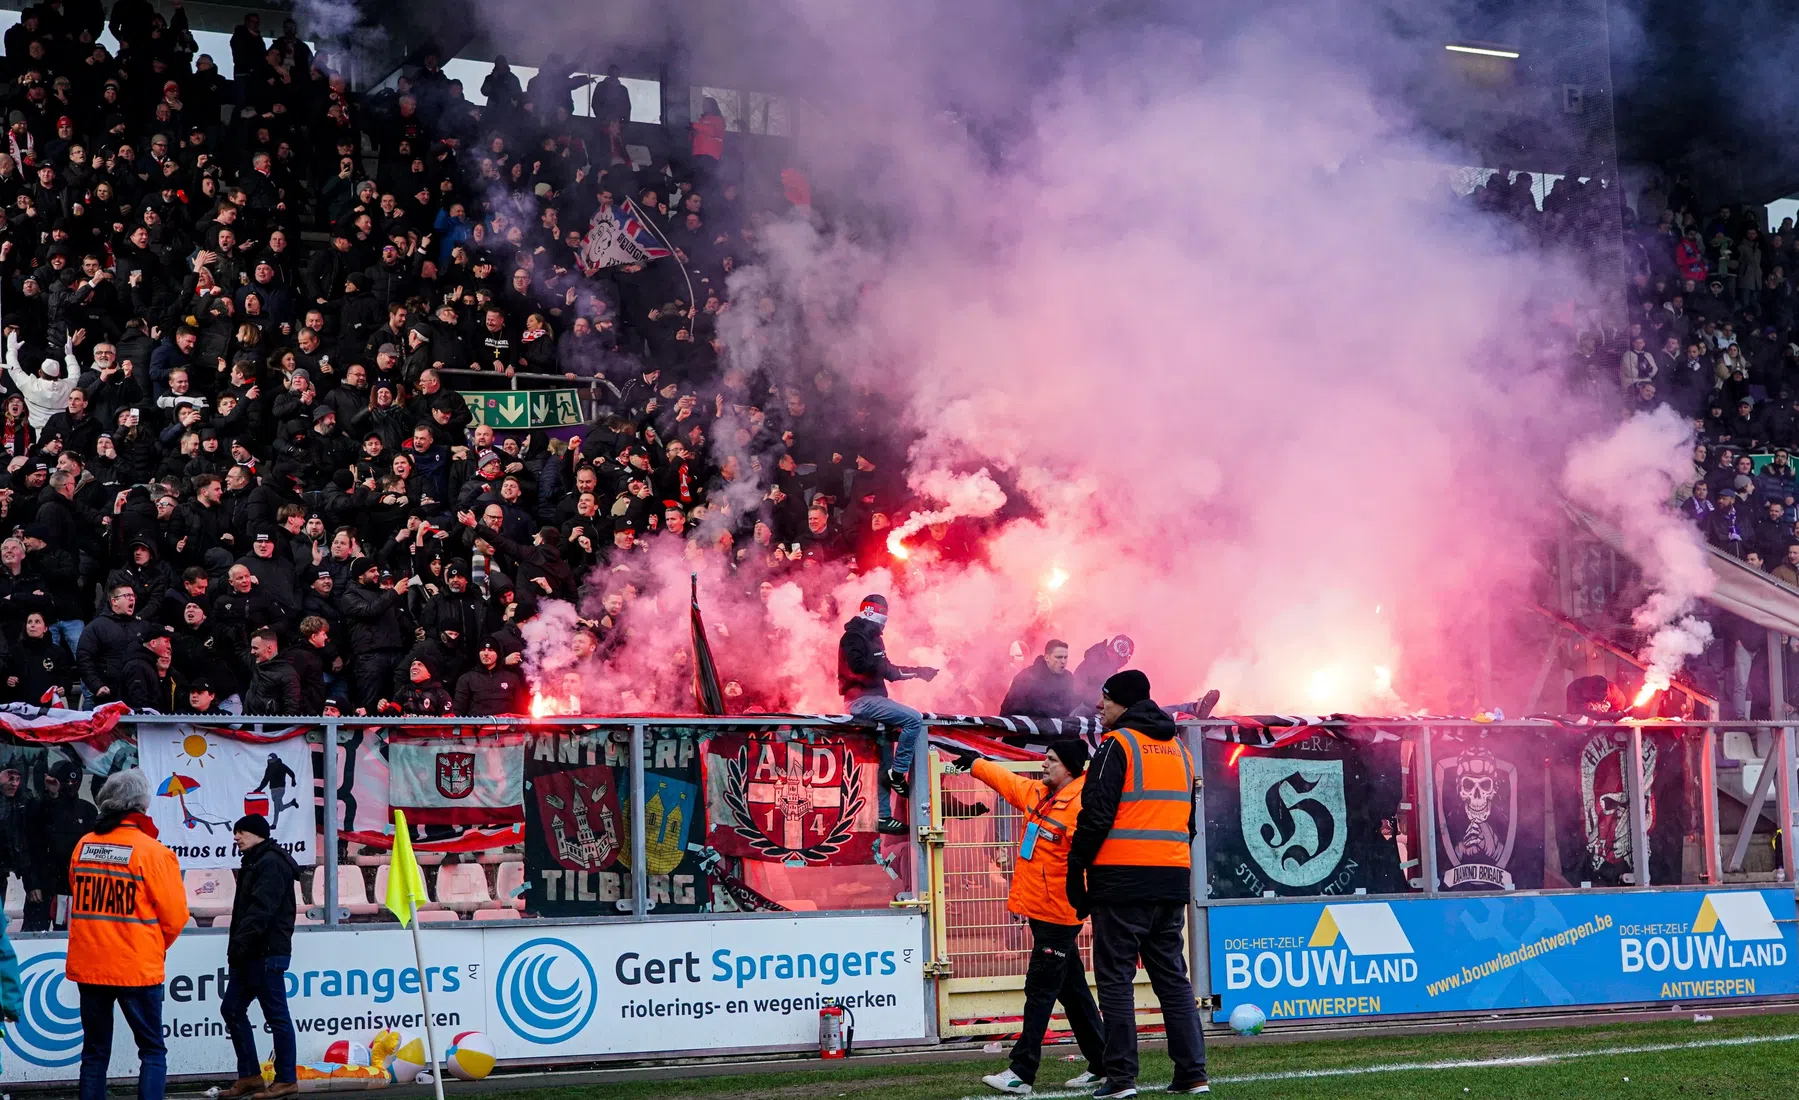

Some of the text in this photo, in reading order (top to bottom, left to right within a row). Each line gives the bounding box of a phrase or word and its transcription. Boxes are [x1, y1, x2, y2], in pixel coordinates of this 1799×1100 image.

[1142, 744, 1182, 758] STEWARD
[811, 747, 837, 784] D
[809, 813, 826, 836] 4
[216, 845, 227, 857] a
[1235, 862, 1267, 896] 5TH
[1479, 865, 1504, 886] BRIGADE
[75, 875, 137, 915] TEWARD
[1619, 923, 1689, 936] DOE-HET-ZELF
[1224, 936, 1305, 951] DOE-HET-ZELF
[902, 948, 914, 964] bv
[1425, 913, 1614, 998] www.bouwlandantwerpen.be
[468, 963, 480, 980] bv
[615, 948, 897, 989] Gert Sprangers
[164, 966, 461, 1003] ert rangers
[1660, 978, 1756, 999] ANTWERPEN
[621, 990, 897, 1019] riolerings- en wegeniswerken
[1271, 996, 1381, 1018] ANTWERPEN
